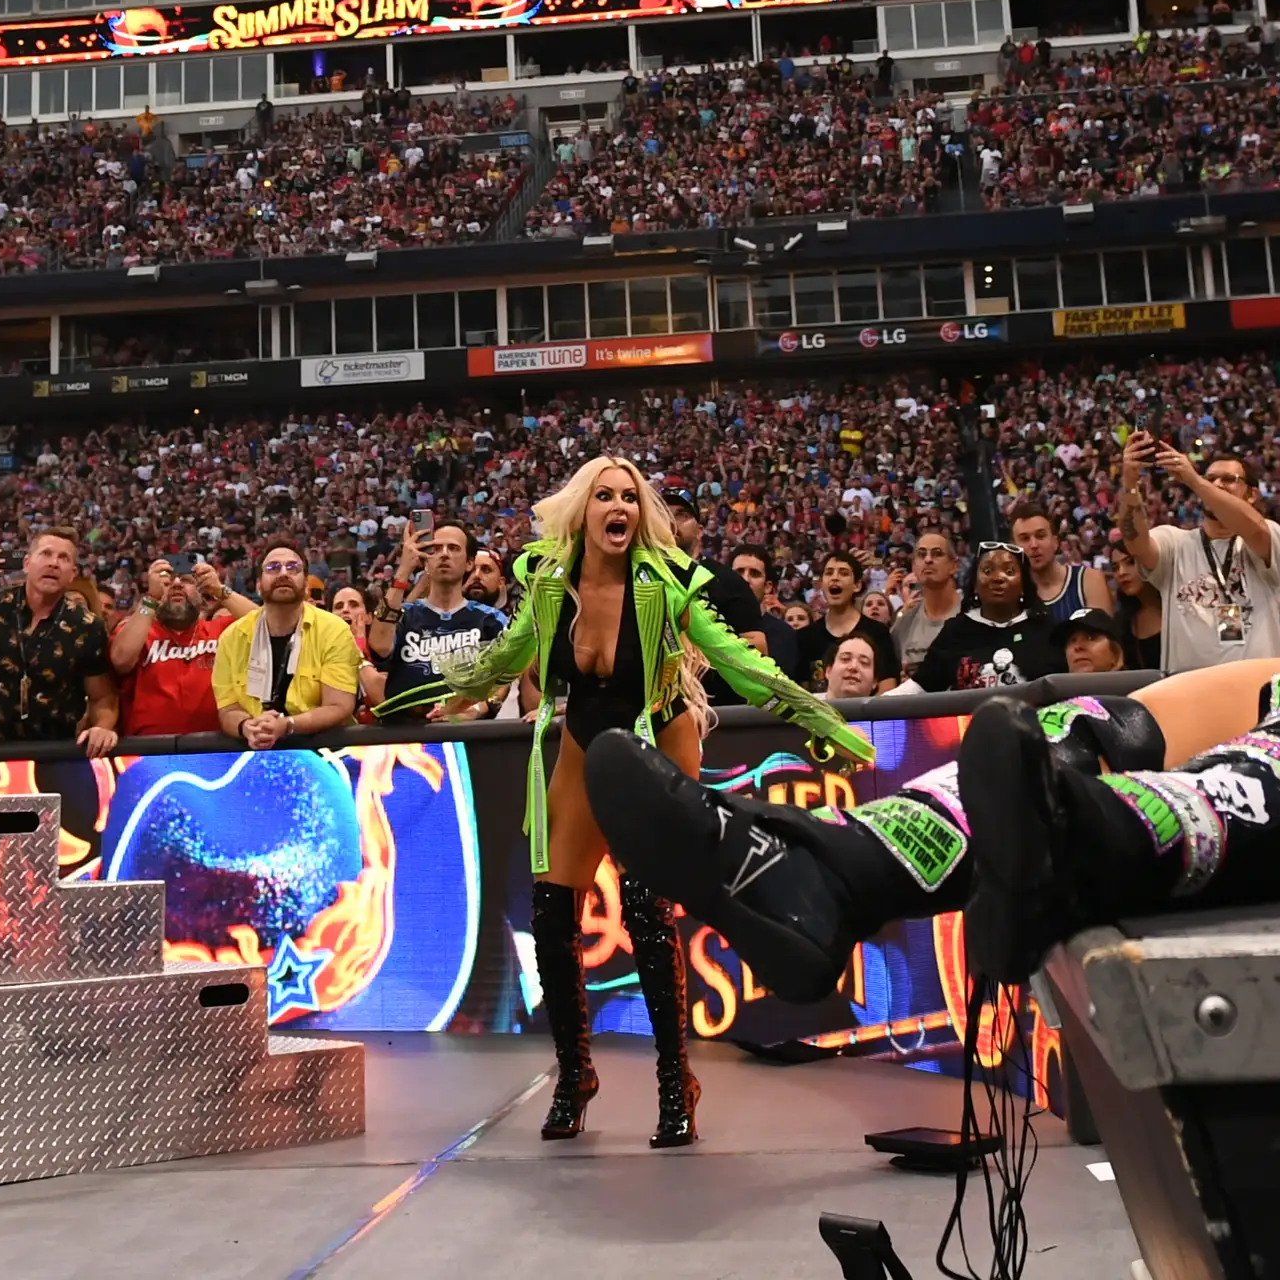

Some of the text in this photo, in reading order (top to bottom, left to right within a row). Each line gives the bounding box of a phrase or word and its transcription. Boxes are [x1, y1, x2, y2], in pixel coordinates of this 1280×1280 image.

[963, 322, 989, 339] LG
[801, 333, 826, 350] LG
[882, 329, 907, 345] LG
[497, 351, 538, 360] AMERICAN
[595, 349, 614, 360] It's
[617, 347, 652, 360] twine
[343, 360, 404, 372] ticketmaster
[497, 358, 537, 368] PAPER &
[128, 377, 169, 387] BETMGM
[208, 372, 248, 383] BETMGM
[51, 381, 91, 392] BETMGM
[401, 627, 481, 663] SUMMER
[891, 825, 939, 875] HISTORY
